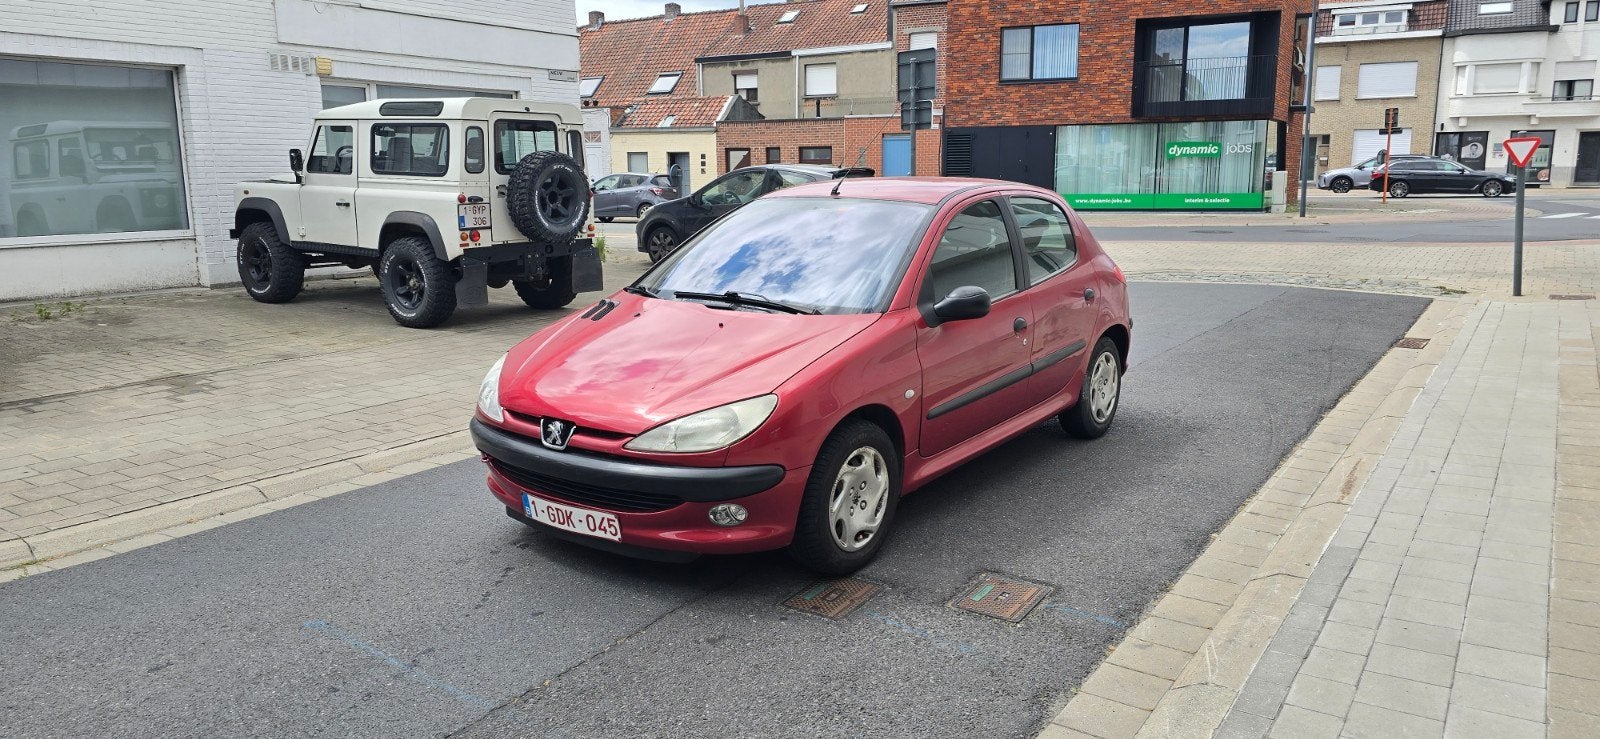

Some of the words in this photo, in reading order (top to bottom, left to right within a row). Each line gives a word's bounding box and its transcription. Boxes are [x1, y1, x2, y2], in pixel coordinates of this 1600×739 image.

[1168, 144, 1218, 157] dynamic
[1226, 142, 1252, 155] jobs
[463, 205, 487, 215] 1-GYP
[472, 217, 487, 226] 306
